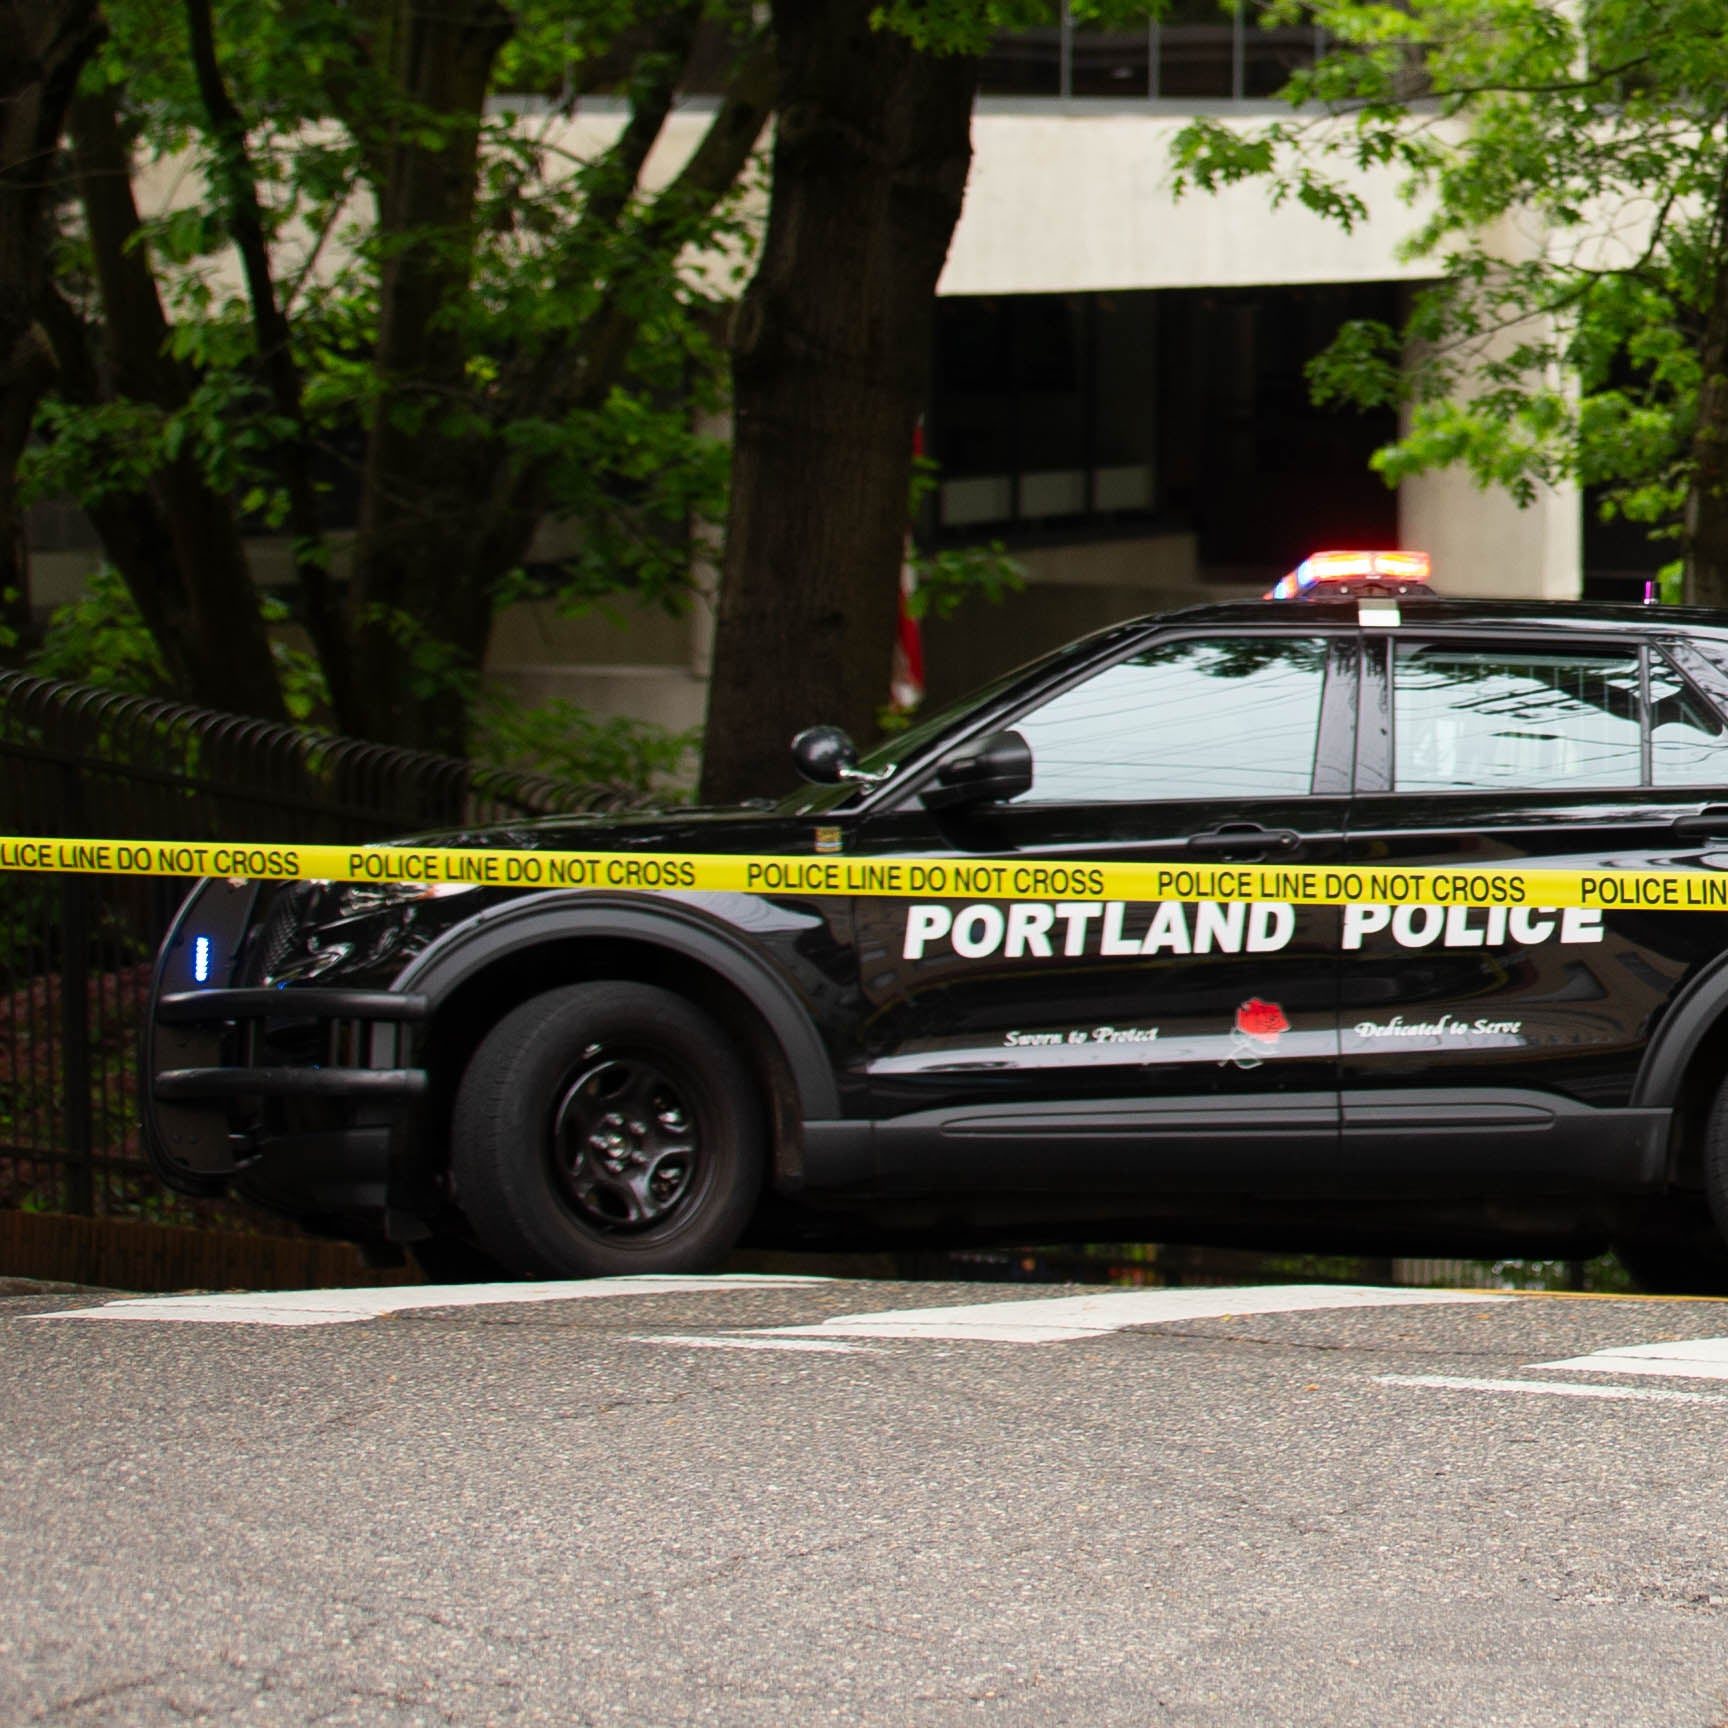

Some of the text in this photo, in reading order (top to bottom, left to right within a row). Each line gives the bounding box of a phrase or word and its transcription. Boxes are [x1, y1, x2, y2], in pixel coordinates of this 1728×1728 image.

[0, 844, 299, 875] LICE LINE DO NOT CROSS
[349, 854, 694, 886] POLICE LINE DO NOT CROSS
[748, 864, 1103, 895] POLICE LINE DO NOT CROSS
[1159, 872, 1524, 902] POLICE LINE DO NOT CROSS
[1582, 878, 1678, 904] POLICE
[903, 901, 1603, 959] PORTLAND POLICE
